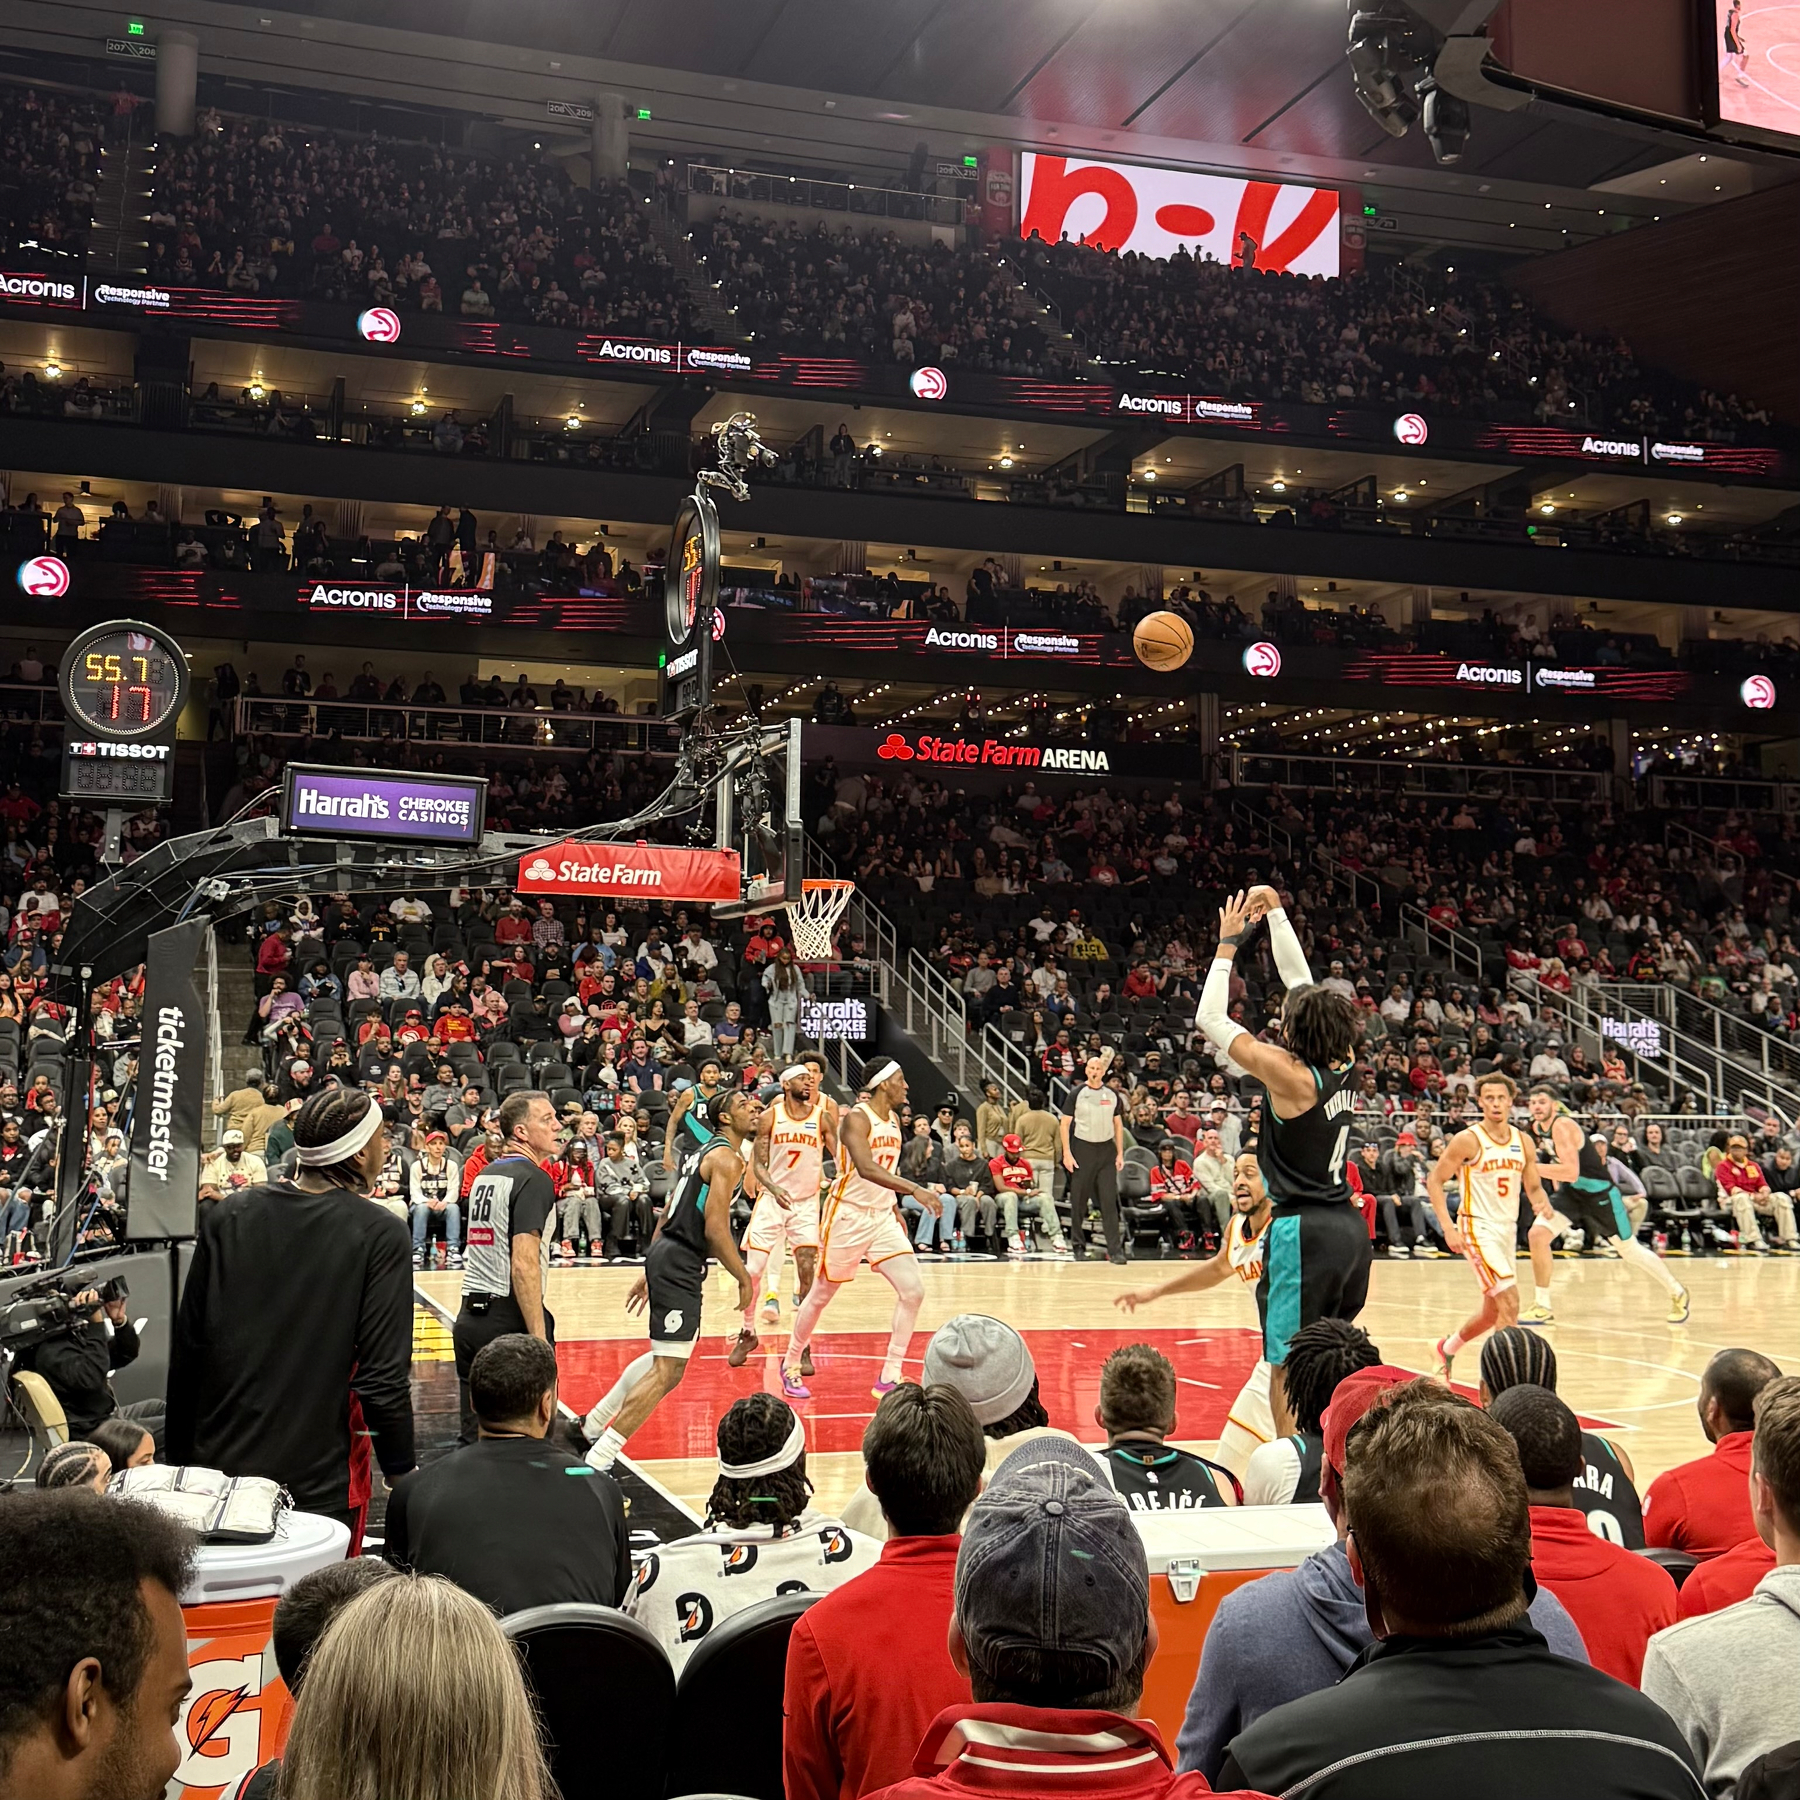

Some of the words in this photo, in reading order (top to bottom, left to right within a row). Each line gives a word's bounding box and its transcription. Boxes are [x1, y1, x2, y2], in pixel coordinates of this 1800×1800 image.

[108, 43, 126, 52] 207
[0, 273, 75, 299] Acronis
[100, 284, 170, 301] Responsive
[599, 340, 671, 363] Acronis
[692, 349, 751, 365] Responsive
[1119, 393, 1182, 414] Acronis
[1581, 437, 1640, 456] Acronis
[310, 584, 396, 609] Acronis
[422, 592, 492, 607] Responsive
[463, 605, 492, 614] Partners
[925, 627, 998, 649] Acronis
[1018, 633, 1079, 647] Responsive
[86, 653, 147, 682] 55.7
[1456, 663, 1522, 684] Acronis
[110, 685, 151, 721] 17
[97, 743, 170, 759] TISSOT
[916, 735, 979, 763] State
[981, 739, 1041, 767] Farm
[1041, 748, 1110, 771] ARENA
[399, 796, 470, 814] CHEROKEE
[398, 809, 469, 826] CASINOS
[840, 1031, 867, 1040] CLUB
[147, 1006, 186, 1181] ticketmaster
[773, 1132, 818, 1148] ATLANTA
[787, 1150, 802, 1169] 7
[878, 1154, 895, 1171] 17
[1328, 1125, 1350, 1186] 4
[1497, 1177, 1510, 1197] 5
[471, 1184, 495, 1222] 36
[1572, 1464, 1614, 1500] ARA
